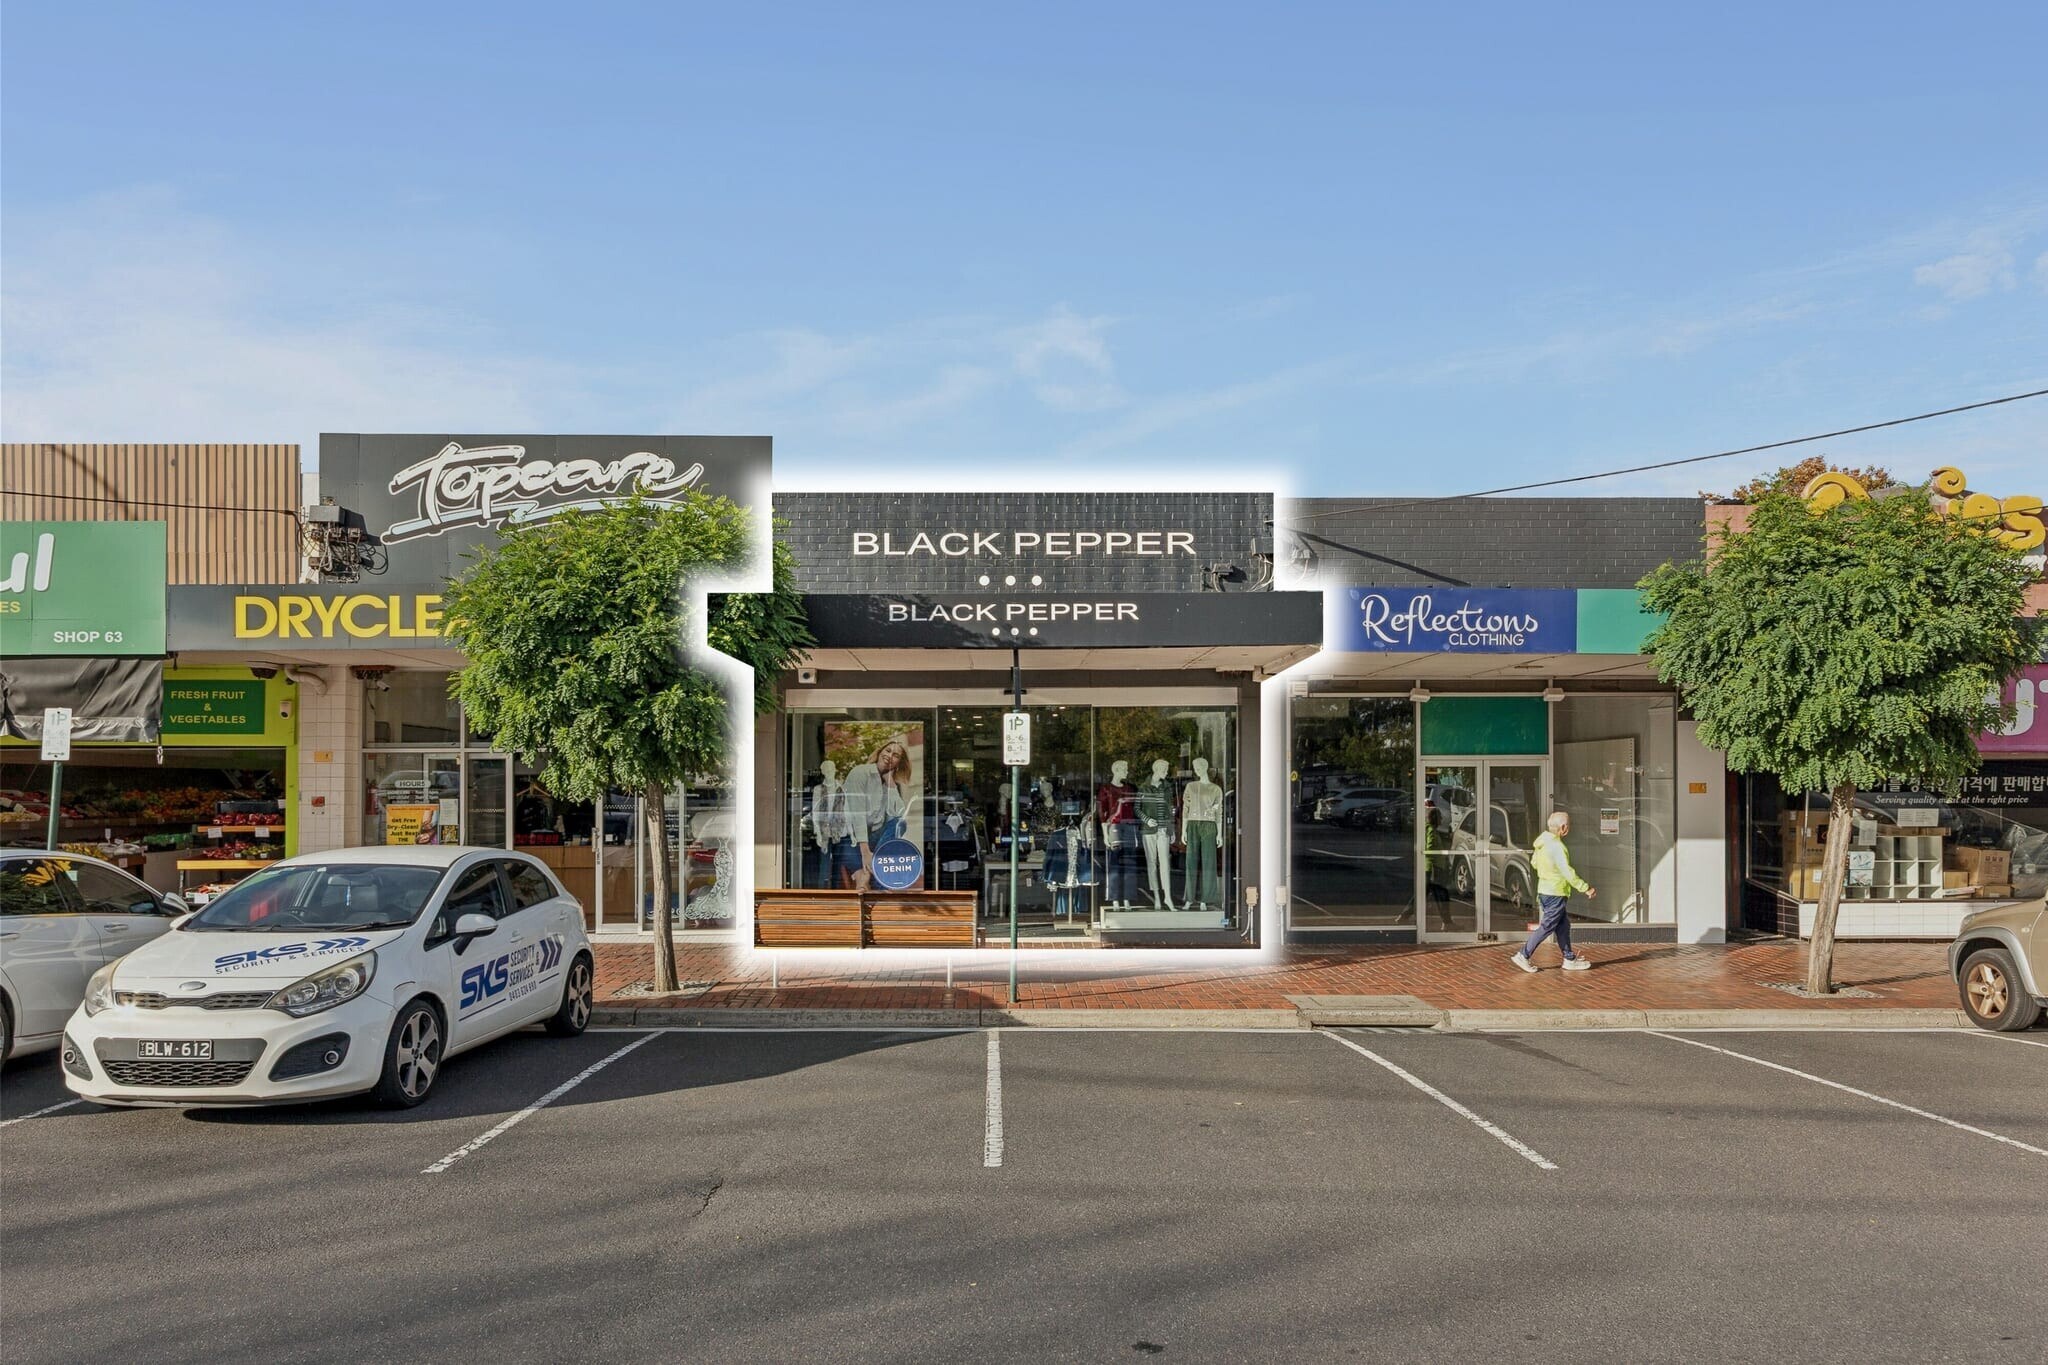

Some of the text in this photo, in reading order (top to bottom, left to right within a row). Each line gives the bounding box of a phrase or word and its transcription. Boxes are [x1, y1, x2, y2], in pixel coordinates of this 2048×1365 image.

[388, 441, 705, 528] Topcare
[853, 532, 1196, 555] BLACK PEPPER
[888, 602, 1140, 622] BLACK PEPPER
[1361, 594, 1538, 645] Reflections
[53, 631, 123, 643] SHOP 63
[1449, 633, 1525, 646] CLOTHING
[170, 690, 246, 700] FRESH FRUIT
[203, 702, 212, 712] &
[169, 715, 247, 724] VEGETABLES
[1009, 718, 1024, 730] 1P
[2003, 776, 2048, 793] 판매합
[1875, 795, 1906, 806] Serving
[1908, 795, 1937, 805] quality
[1961, 796, 1970, 804] at
[1971, 795, 1986, 804] the
[1987, 795, 2007, 806] right
[2008, 795, 2029, 805] price
[877, 857, 895, 865] 25%
[883, 865, 912, 873] DENIM
[214, 942, 308, 969] SKS
[215, 956, 282, 975] SECURITY
[303, 946, 365, 958] SERVICES
[510, 944, 535, 967] SECURITY
[460, 954, 509, 1009] SKS
[508, 963, 535, 988] SERVICES
